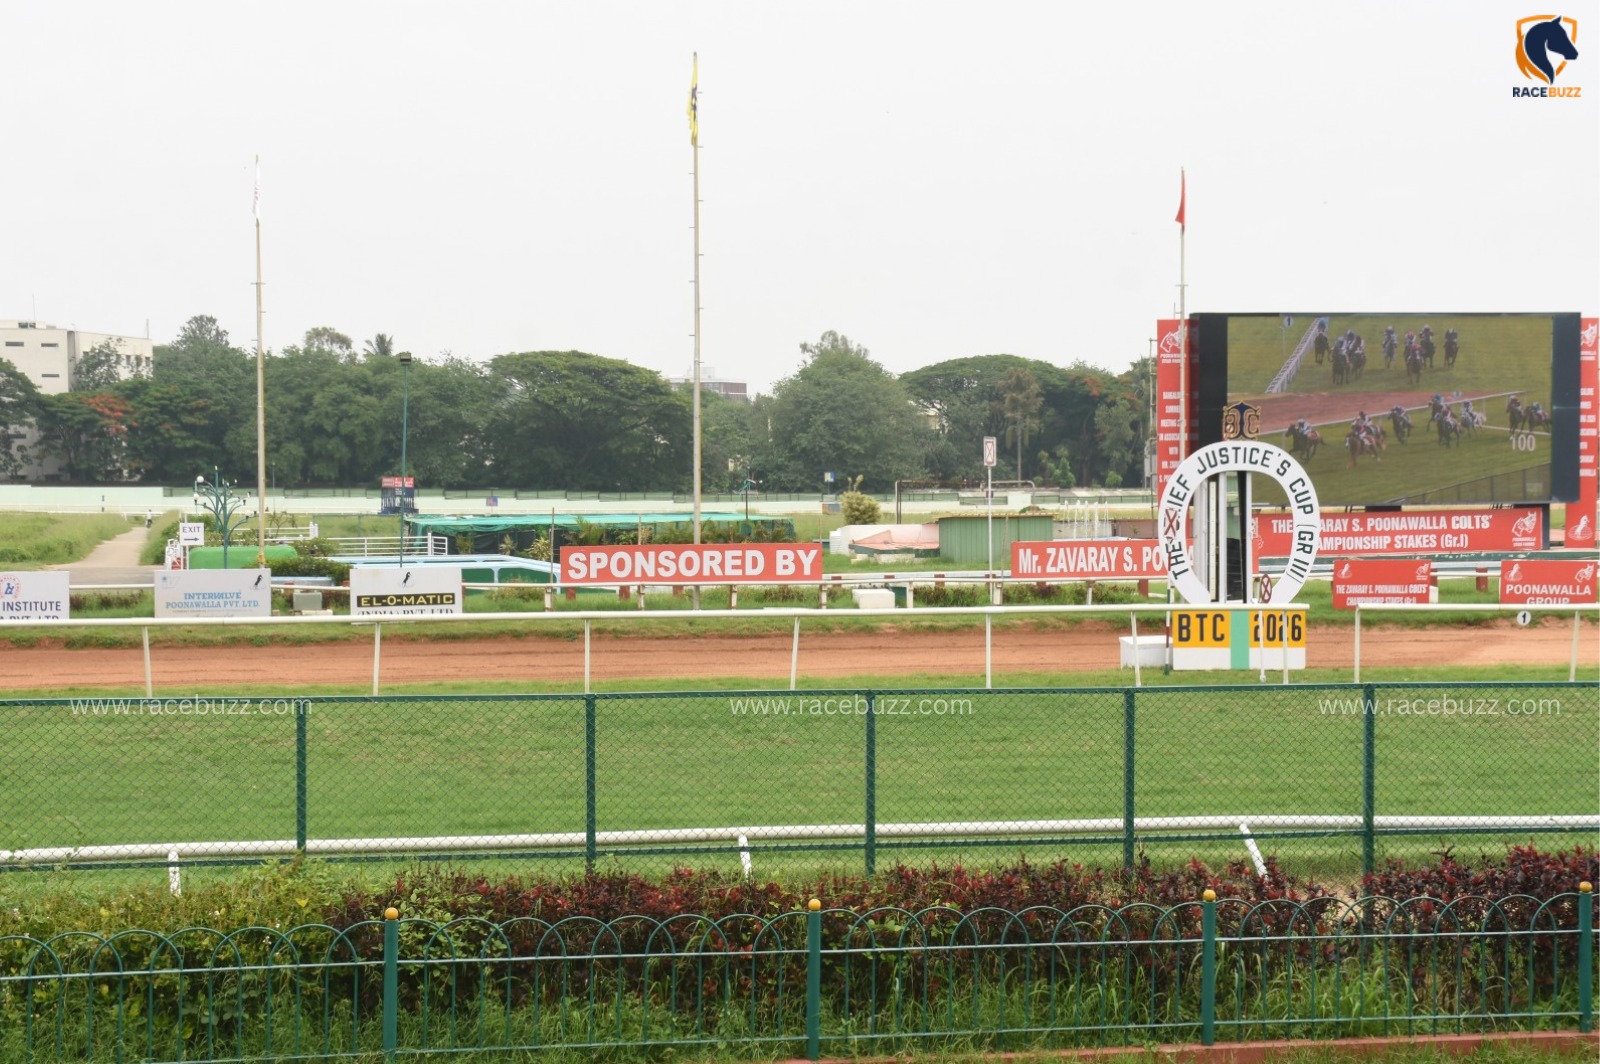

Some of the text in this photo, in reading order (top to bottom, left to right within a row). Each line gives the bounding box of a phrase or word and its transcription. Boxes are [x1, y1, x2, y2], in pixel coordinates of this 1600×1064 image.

[1510, 434, 1536, 451] 100
[1197, 447, 1291, 477] JUSTICE'S
[1289, 478, 1314, 515] CUP
[1272, 519, 1293, 533] THE
[1352, 518, 1364, 532] S.
[1367, 515, 1448, 532] POONAWALLA
[1296, 524, 1318, 555] (GR
[1318, 535, 1391, 551] AMPIONSHIP
[1394, 534, 1437, 549] STAKES
[567, 550, 818, 580] SPONSORED BY
[1018, 548, 1042, 574] Mr.
[1046, 547, 1118, 573] ZAVARAY
[1123, 546, 1137, 572] S.
[1165, 541, 1189, 580] THE
[360, 594, 454, 606] EL-O-MATIC
[1506, 584, 1592, 596] POONAWALLA
[3, 601, 62, 611] INSTITUTE
[165, 601, 221, 609] POONAWALLA
[1178, 613, 1225, 642] BTC
